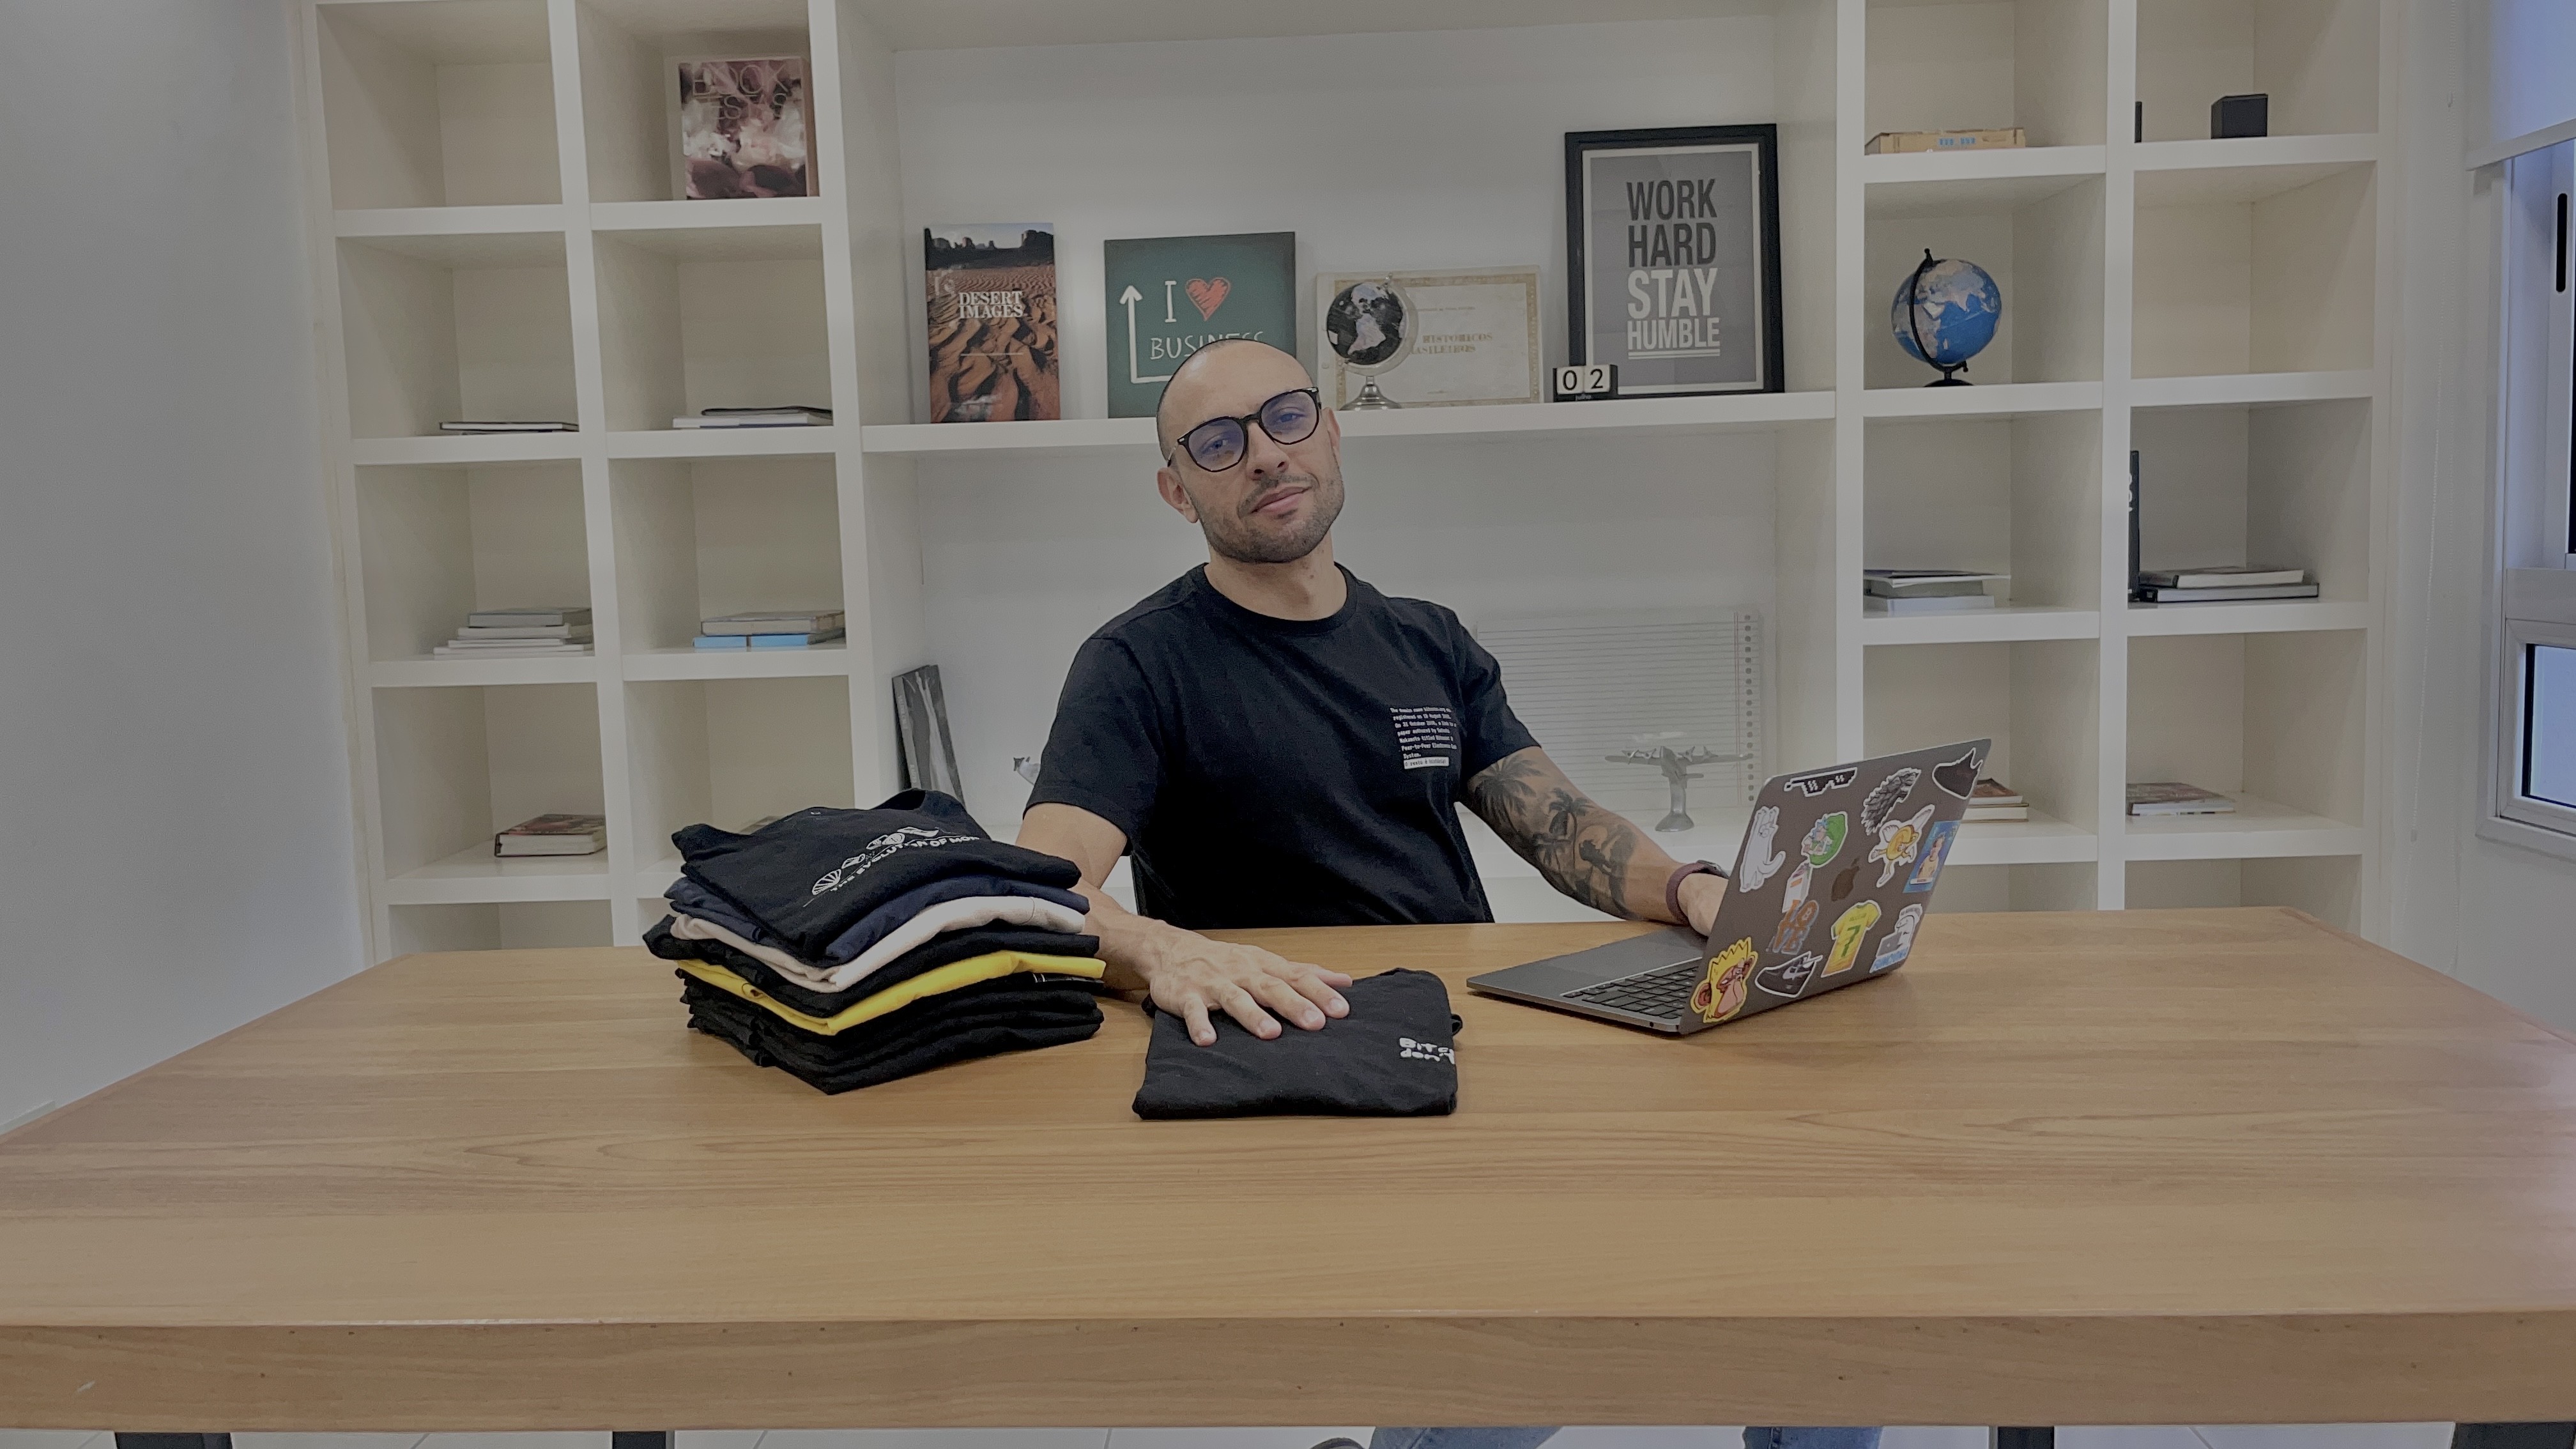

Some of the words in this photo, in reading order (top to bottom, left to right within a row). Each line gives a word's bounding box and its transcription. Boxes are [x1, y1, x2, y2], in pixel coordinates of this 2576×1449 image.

[1627, 178, 1717, 221] WORK
[1628, 222, 1716, 268] HARD
[959, 291, 1022, 305] DESERT
[1165, 280, 1177, 323] I
[1627, 268, 1718, 319] STAY
[960, 304, 1023, 319] IMAGES
[1151, 331, 1264, 360] BUSI
[1627, 318, 1720, 350] HUMBLE
[930, 838, 947, 847] OF
[1841, 924, 1862, 958] 7
